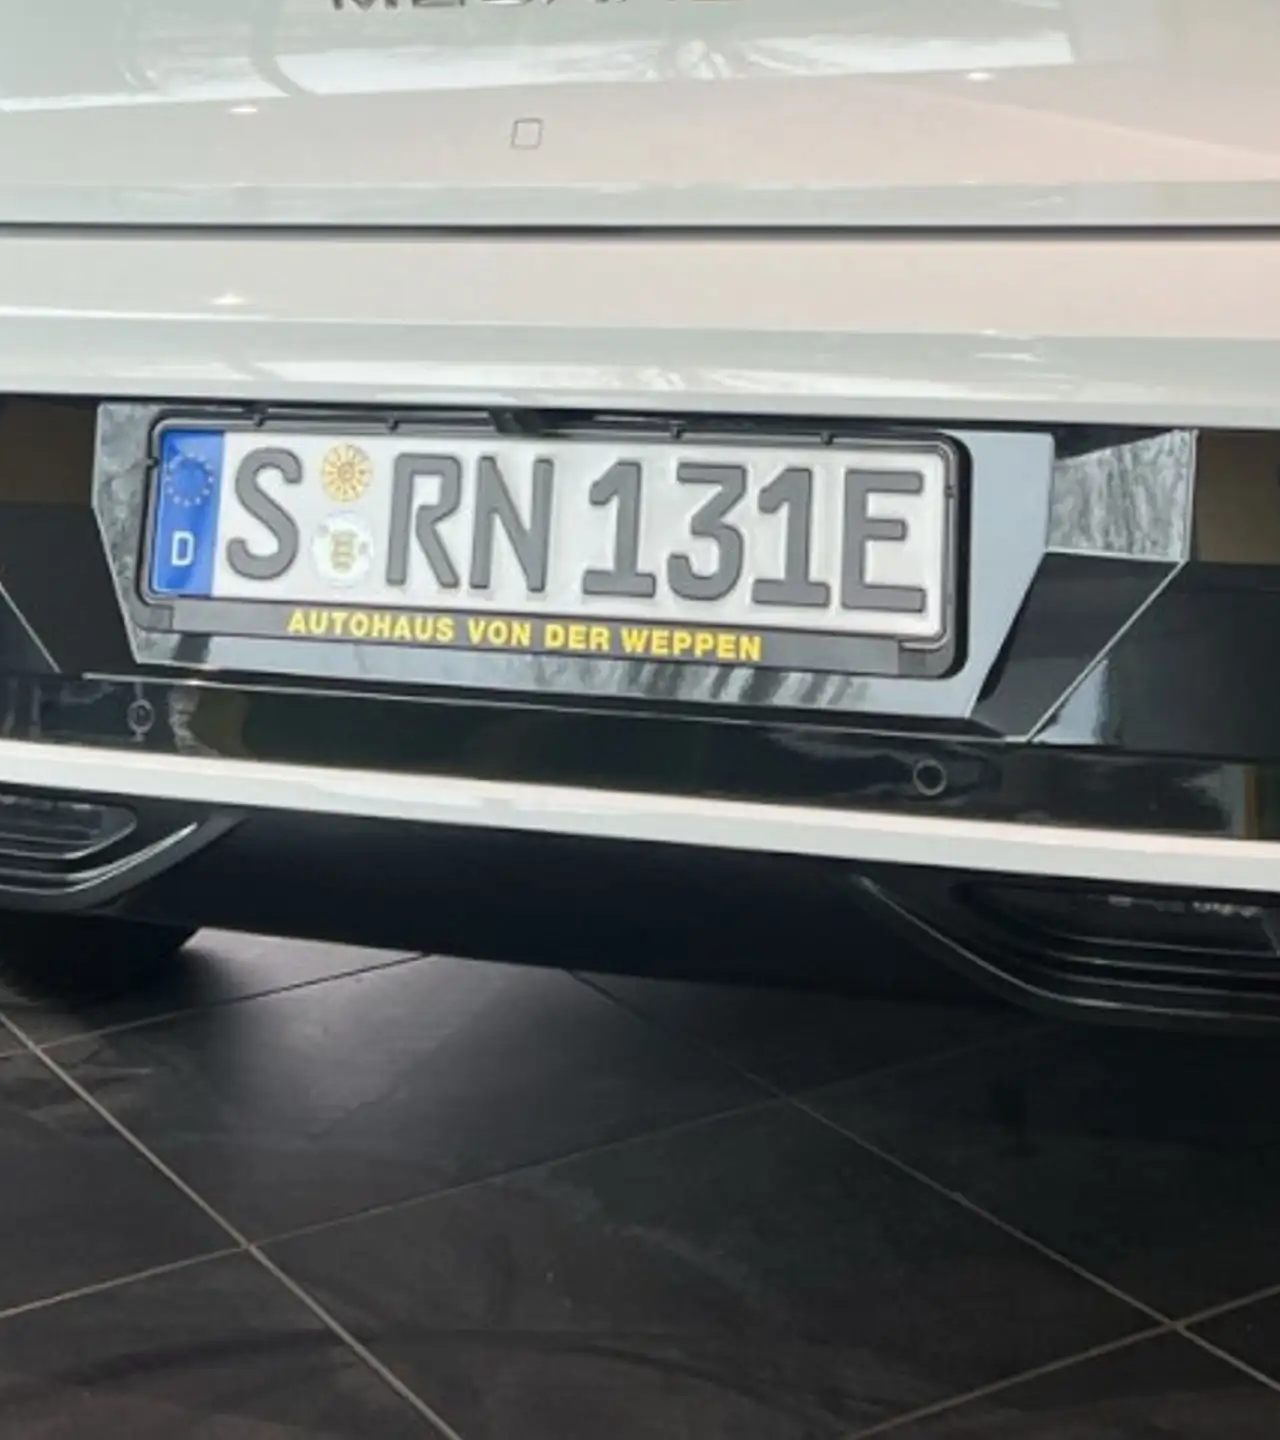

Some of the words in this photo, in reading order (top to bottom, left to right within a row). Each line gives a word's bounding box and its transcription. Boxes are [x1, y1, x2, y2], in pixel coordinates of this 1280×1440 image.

[171, 530, 193, 566] D
[226, 446, 303, 579] S
[386, 452, 554, 593] RN
[582, 461, 926, 613] 131E
[287, 609, 455, 642] AUTOHAUS
[468, 620, 532, 647] VON
[545, 623, 611, 652] DER
[621, 628, 762, 662] WEPPEN
